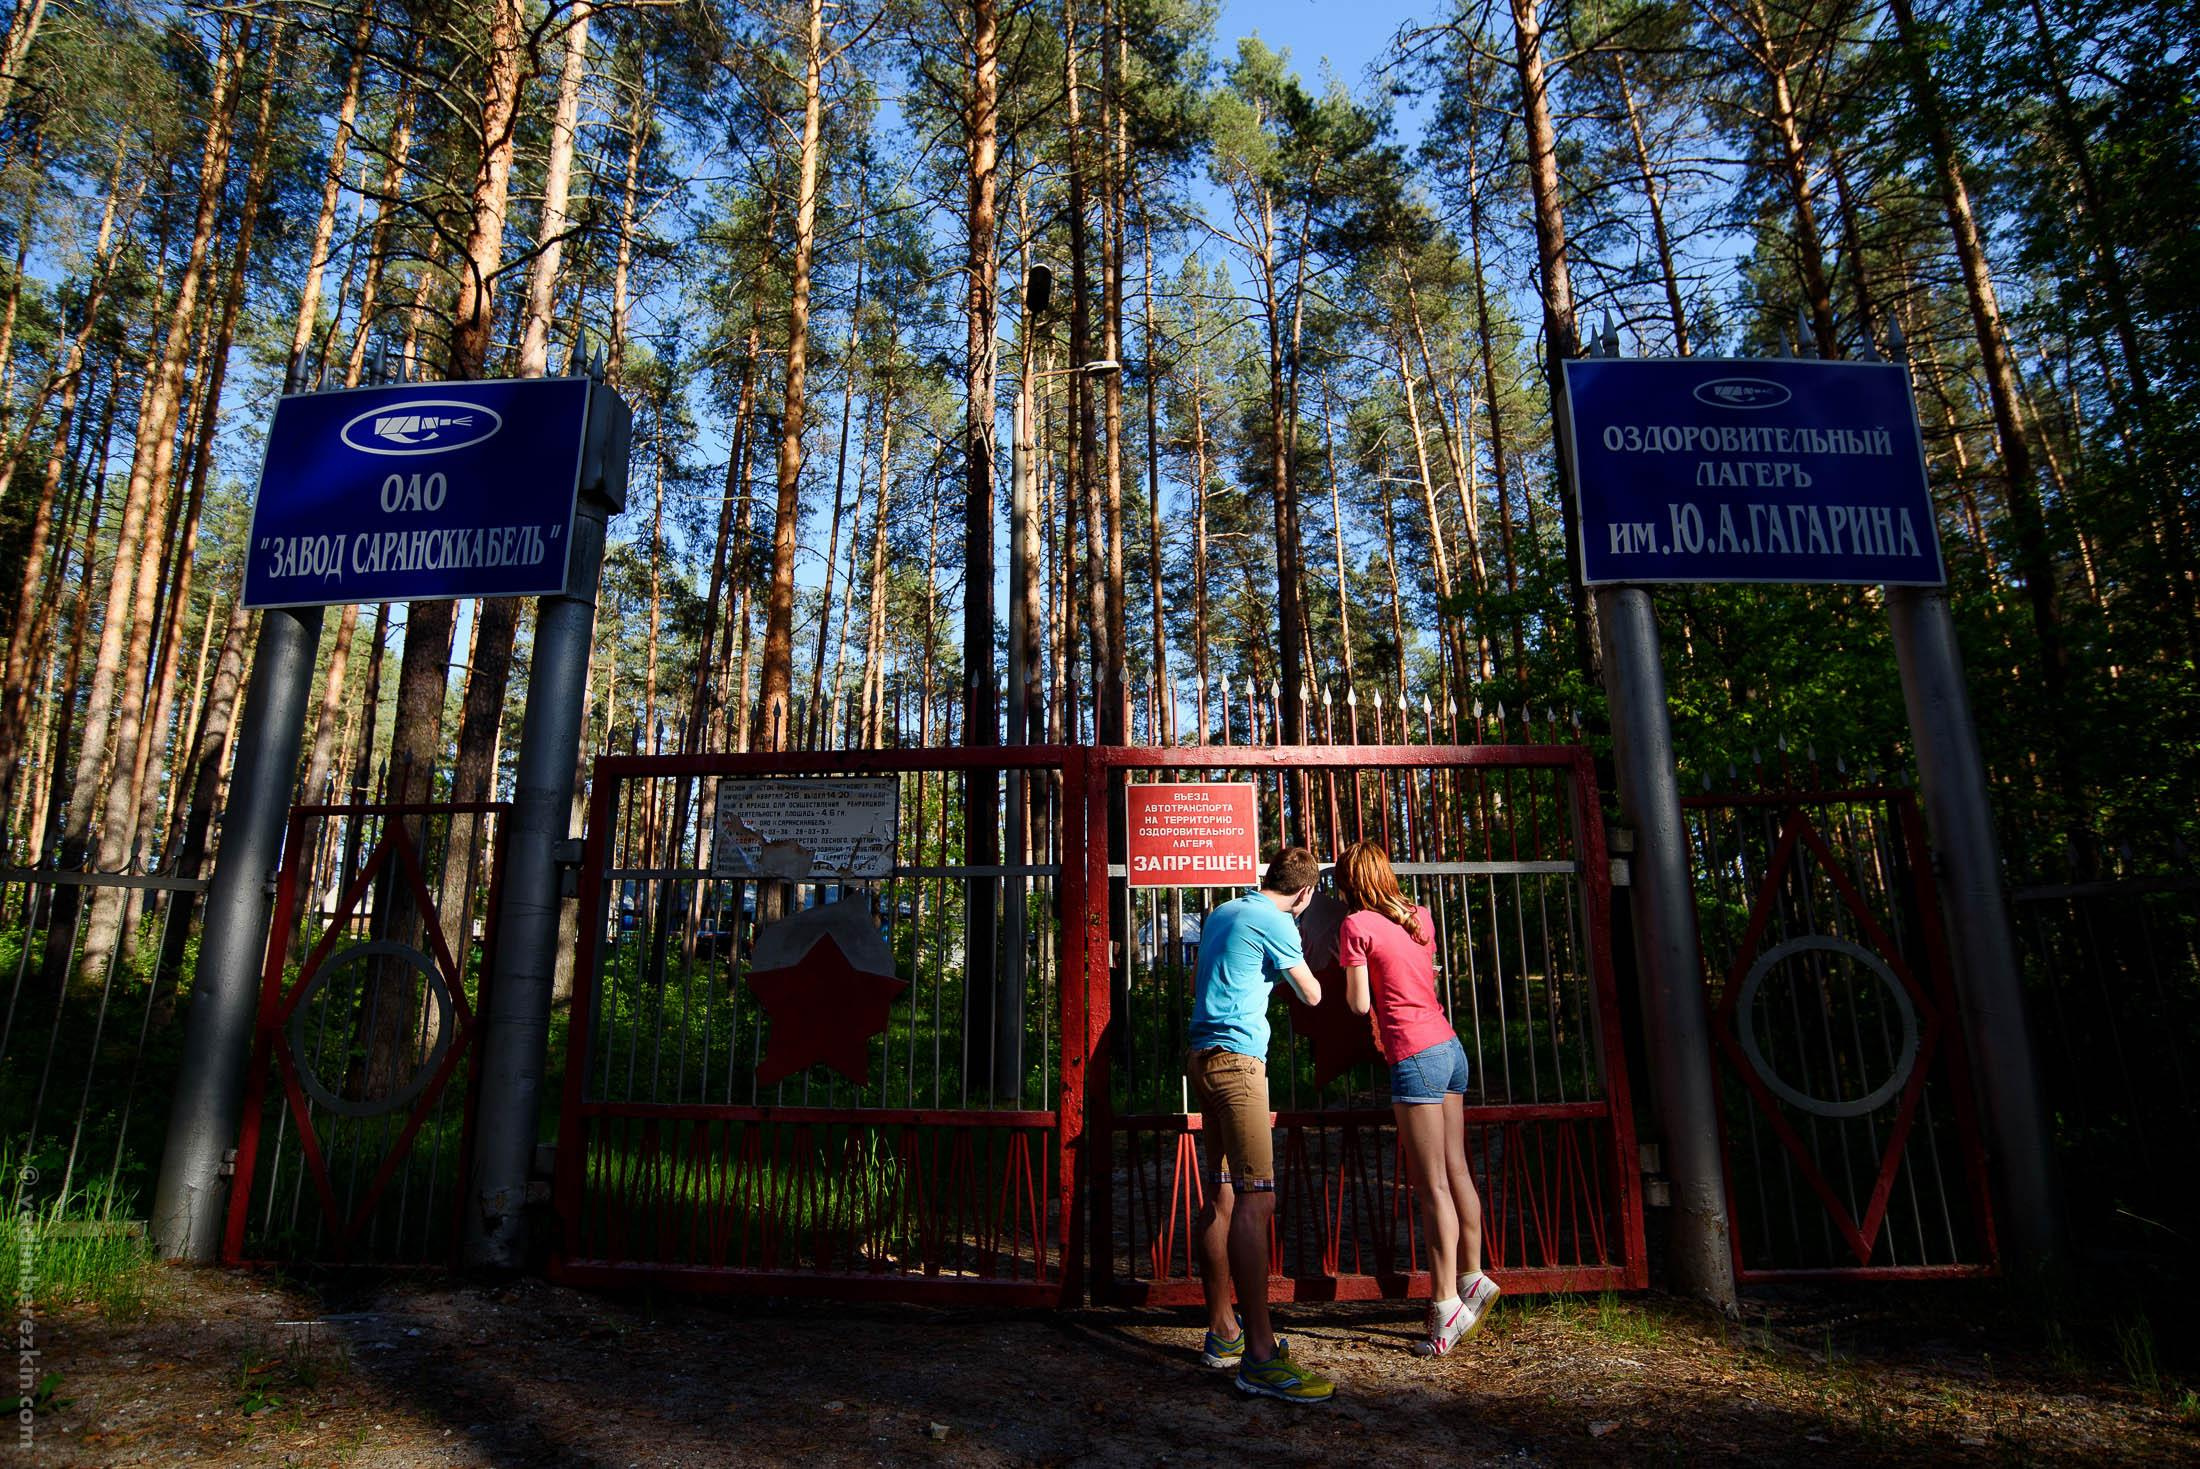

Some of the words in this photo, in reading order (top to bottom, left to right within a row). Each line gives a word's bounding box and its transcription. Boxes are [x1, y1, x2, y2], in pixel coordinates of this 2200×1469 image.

[1603, 425, 1894, 456] ОЗДОРОВИТЕЛЬНЫЙ
[1696, 461, 1813, 488] ЛАГЕРЬ
[380, 472, 447, 513] ОАО
[260, 534, 347, 585] "ЗАВОД
[1144, 803, 1234, 813] АВТОТРАНСПОРТА
[1144, 815, 1158, 825] НА
[1164, 815, 1232, 825] ТЕРРИТОРИЮ
[1139, 827, 1245, 837] ОЗДОРОВИТЕЛЬНОГО
[1172, 839, 1214, 848] ЛАГЕРЯ
[1133, 852, 1253, 872] ЗАПРЕЩЁН
